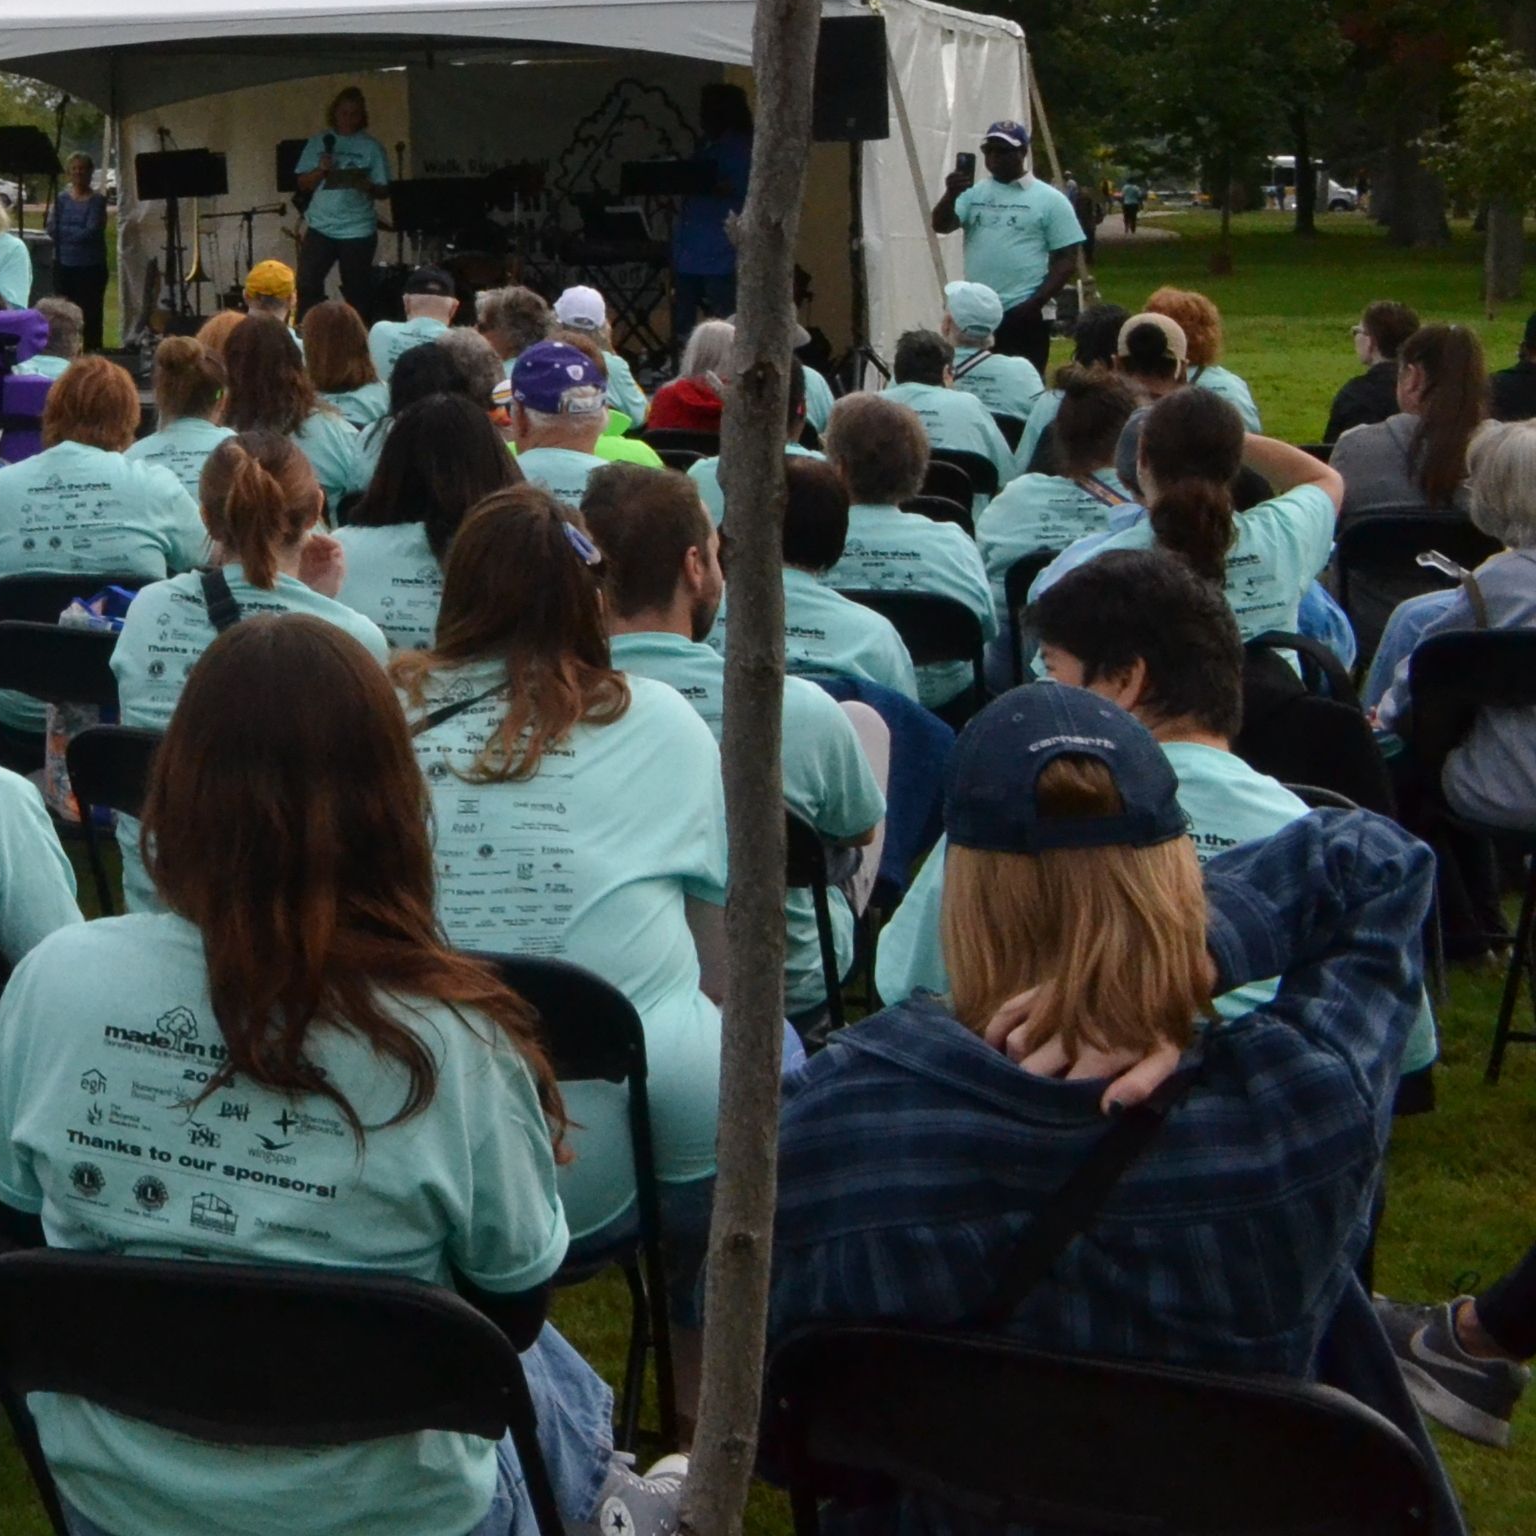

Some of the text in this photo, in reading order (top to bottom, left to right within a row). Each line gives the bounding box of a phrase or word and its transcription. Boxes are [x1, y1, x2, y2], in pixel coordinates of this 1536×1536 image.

[104, 1024, 229, 1060] made in th
[80, 1073, 107, 1095] egh
[66, 1129, 337, 1199] Thanks to our sponsors!
[247, 1146, 297, 1165] wingspan
